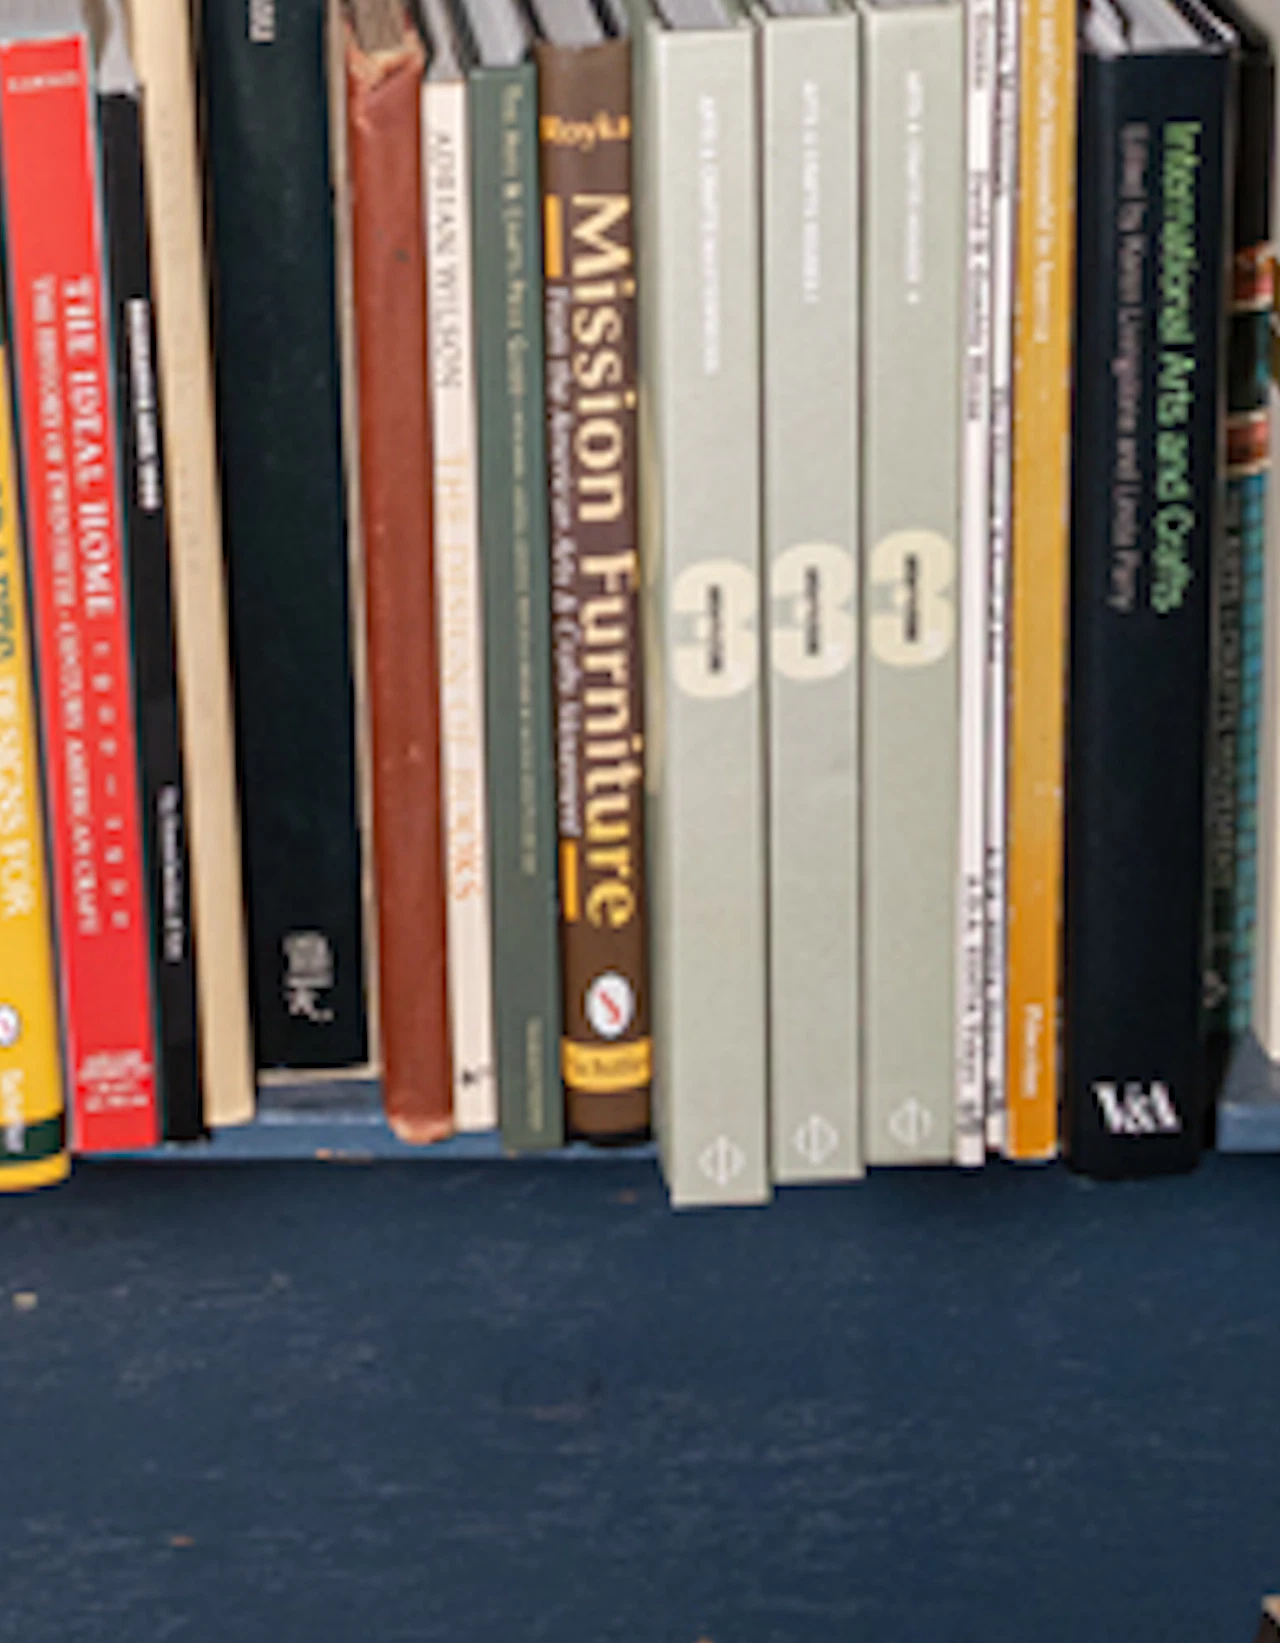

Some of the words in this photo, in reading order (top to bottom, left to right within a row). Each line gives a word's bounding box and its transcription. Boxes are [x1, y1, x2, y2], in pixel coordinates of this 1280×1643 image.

[1158, 124, 1201, 341] International
[31, 273, 57, 320] THE
[63, 275, 96, 357] THE
[542, 288, 570, 352] From
[35, 326, 63, 424] HISTORY
[546, 362, 571, 401] the
[570, 194, 636, 522] Mission
[1157, 352, 1194, 418] Arts
[68, 369, 106, 485] IDEAL
[548, 412, 576, 529] American
[1157, 433, 1194, 498] and
[78, 502, 117, 615] HOME
[551, 537, 578, 581] Arts
[1150, 510, 1190, 612] Crafts
[579, 549, 645, 928] Furniture
[0, 838, 34, 918] FOR
